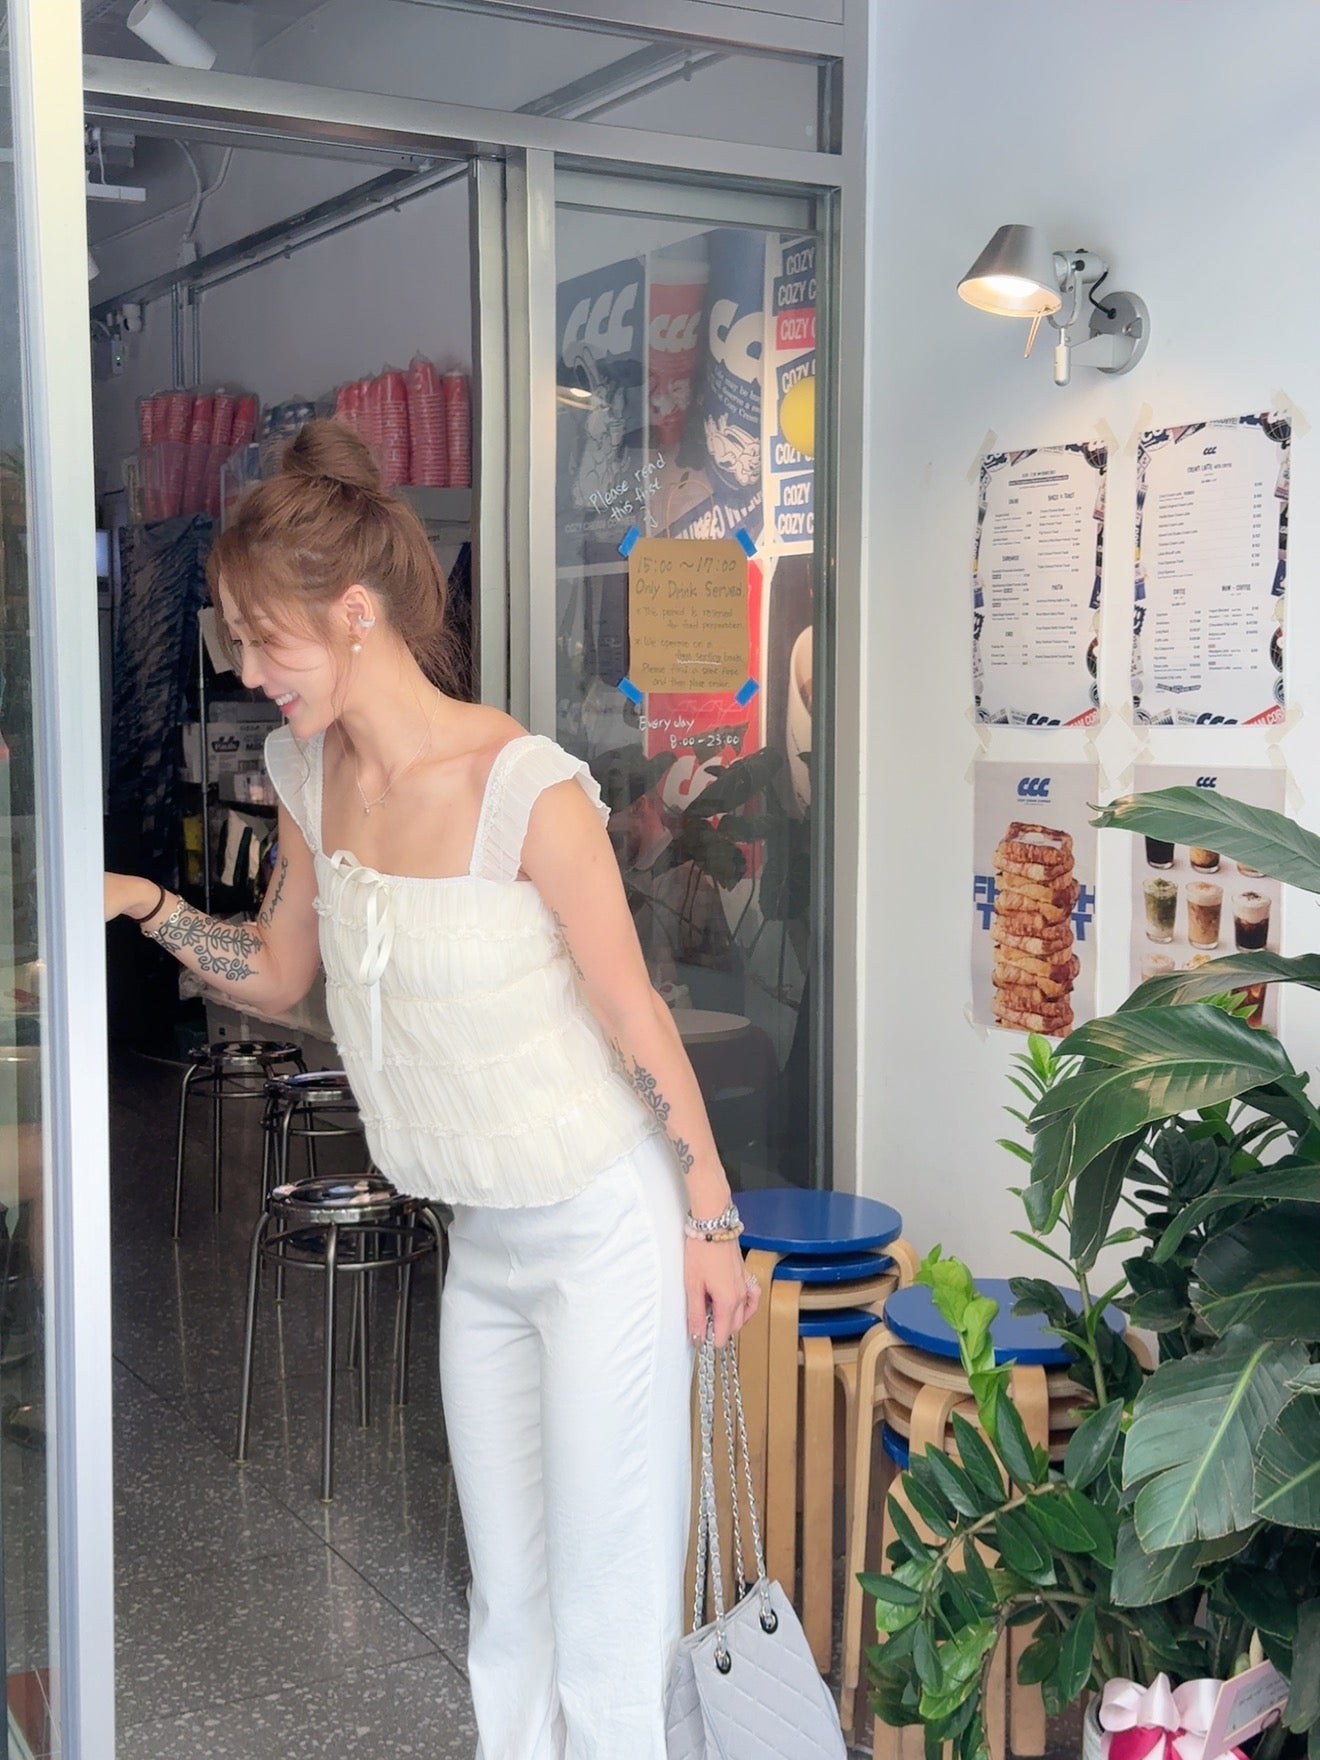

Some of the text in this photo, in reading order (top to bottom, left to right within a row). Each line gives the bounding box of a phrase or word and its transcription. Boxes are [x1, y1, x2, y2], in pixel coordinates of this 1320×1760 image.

[787, 247, 815, 276] COZY
[778, 282, 806, 307] COZY
[561, 281, 639, 369] CCC
[649, 311, 702, 353] CCC
[780, 319, 808, 342] COZY
[588, 479, 630, 515] Please
[610, 500, 633, 522] this
[634, 477, 662, 504] first
[784, 482, 811, 506] COZY
[778, 513, 805, 536] COZY
[635, 578, 661, 599] Only
[668, 578, 698, 598] Drink
[1016, 777, 1051, 798] CCC
[1195, 776, 1218, 788] CCC
